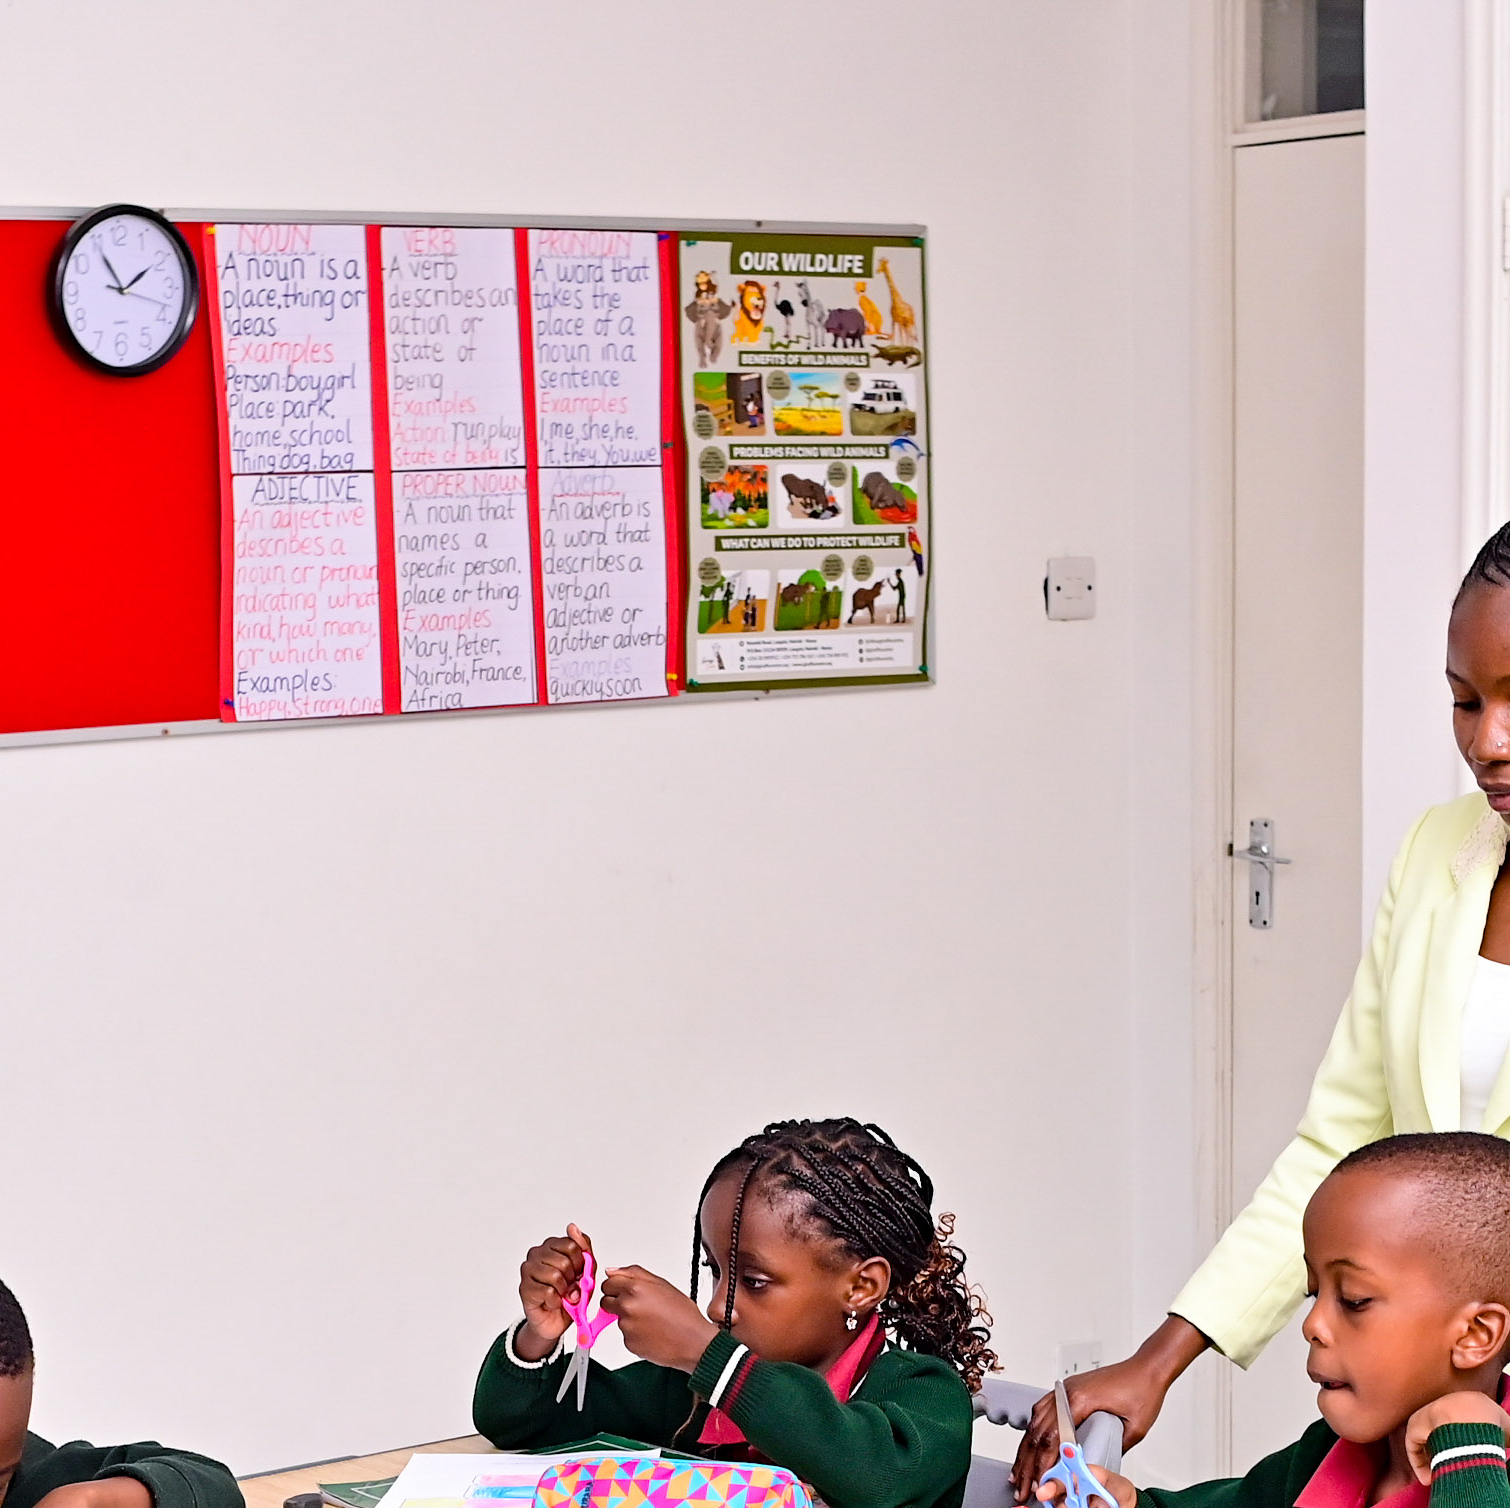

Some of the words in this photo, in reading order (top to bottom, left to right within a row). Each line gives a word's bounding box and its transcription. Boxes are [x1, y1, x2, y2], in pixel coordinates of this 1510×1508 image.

[247, 256, 306, 281] noun
[739, 251, 779, 271] OUR
[781, 252, 864, 273] WILDLIFE
[114, 332, 128, 356] 6
[741, 354, 787, 365] BENEFITS
[787, 354, 801, 365] OF
[801, 355, 825, 365] WILD
[825, 355, 867, 365] ANIMALS
[733, 447, 784, 458] PROBLEMS
[784, 447, 819, 458] FACING
[819, 447, 844, 458] WILD
[845, 447, 886, 458] ANIMALS
[251, 476, 358, 503] ADJECTIVE
[403, 473, 466, 495] PROPER
[427, 504, 472, 523] noun
[477, 500, 515, 520] that
[397, 532, 460, 552] names
[721, 538, 749, 549] WHAT
[750, 538, 771, 549] CAN
[771, 538, 786, 548] WE
[787, 538, 802, 548] DO
[803, 538, 816, 548] TO
[816, 537, 857, 548] PROTECT
[857, 536, 900, 547] WILDLIFE
[402, 585, 447, 610] place
[403, 609, 492, 634] Examples
[408, 691, 463, 710] Africa
